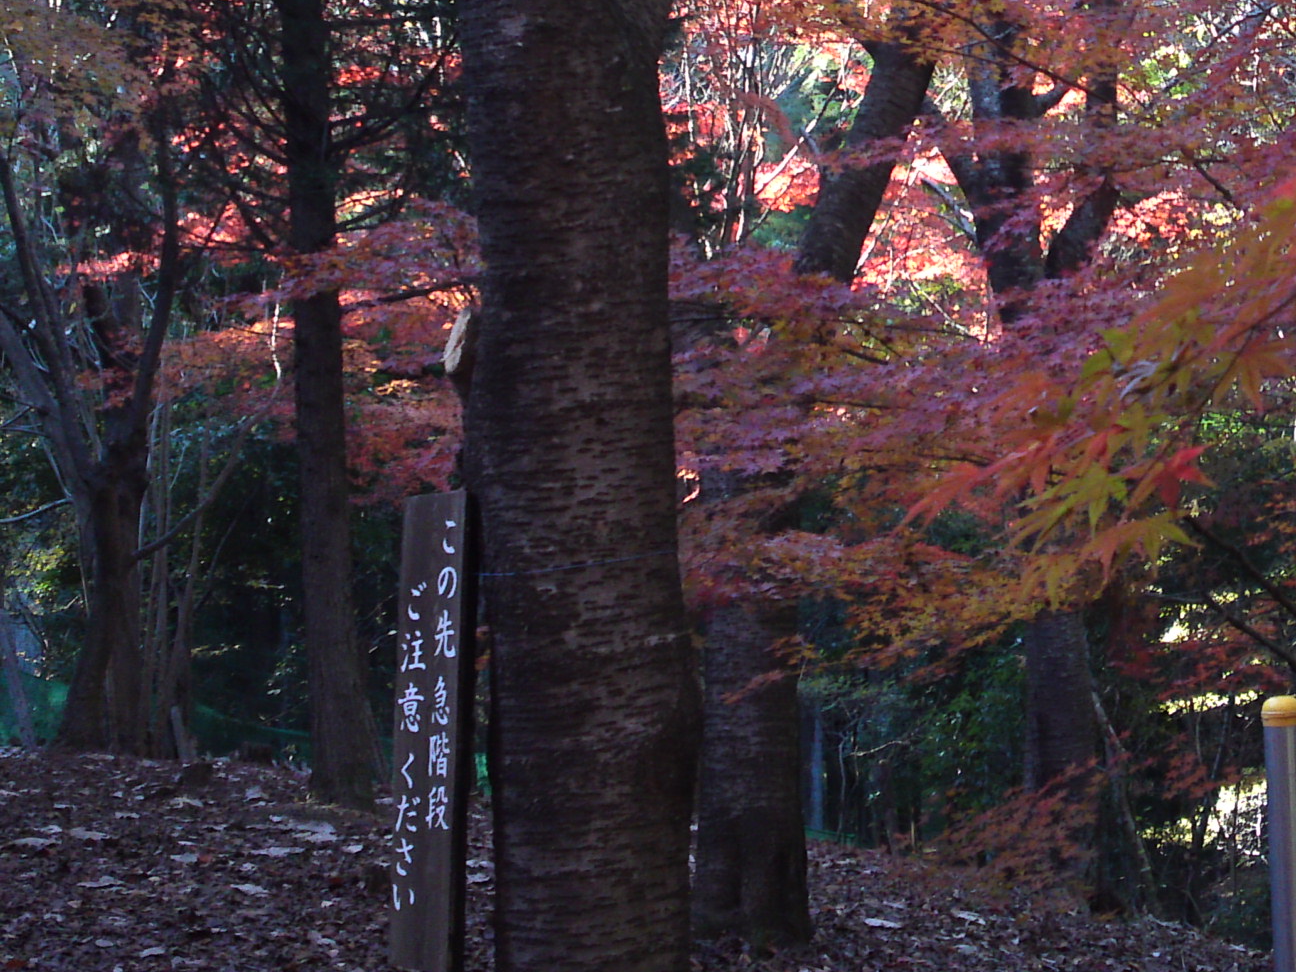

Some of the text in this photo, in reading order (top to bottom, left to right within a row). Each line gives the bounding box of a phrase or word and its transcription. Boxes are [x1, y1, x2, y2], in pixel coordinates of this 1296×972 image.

[392, 581, 427, 911] ご注意ください
[425, 520, 458, 830] この先急階段
